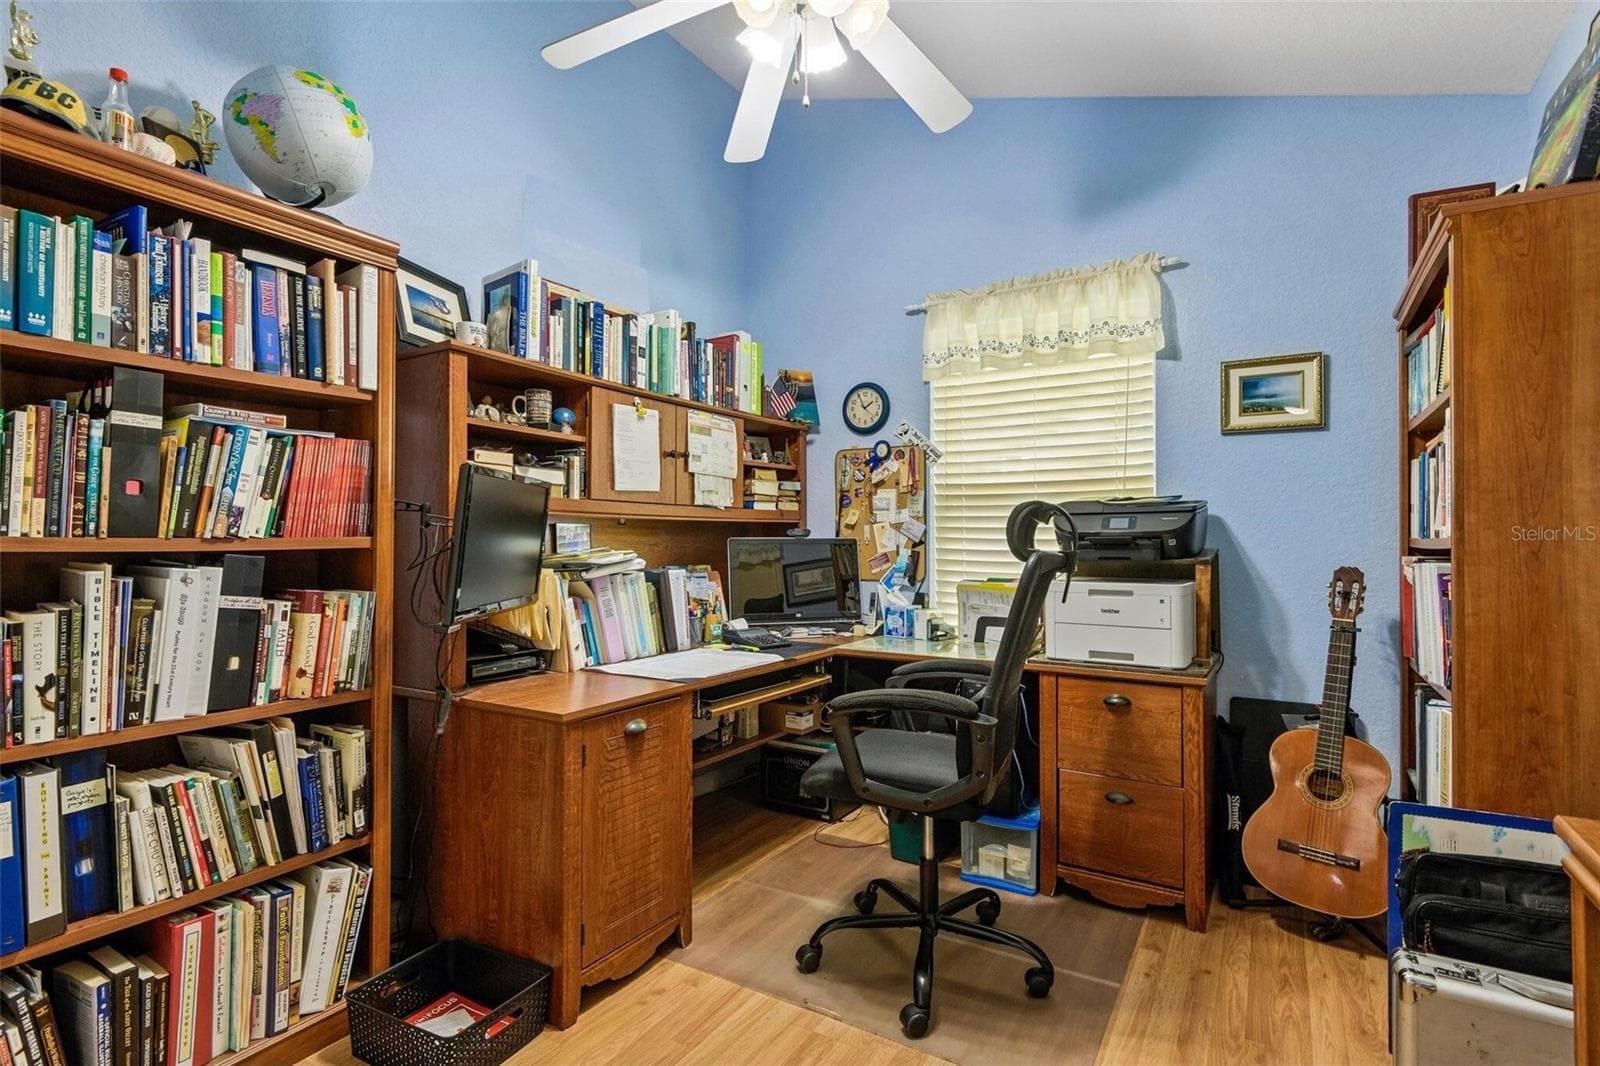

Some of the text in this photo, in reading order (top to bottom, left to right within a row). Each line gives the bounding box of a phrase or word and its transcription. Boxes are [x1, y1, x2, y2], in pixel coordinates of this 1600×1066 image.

[96, 255, 107, 309] christian history
[152, 237, 168, 285] Paul Johnson
[197, 259, 208, 294] HANDBOOK
[159, 302, 169, 323] History
[260, 280, 276, 318] HERESIES
[232, 429, 245, 456] CHOSEN
[90, 467, 100, 488] Grace
[33, 621, 43, 672] THE STORY
[89, 632, 100, 704] TIMELINE
[304, 621, 316, 668] God Good
[784, 756, 810, 768] UNION
[40, 782, 49, 845] EQUIPPING
[142, 806, 157, 839] SIMPE
[278, 906, 290, 934] Faith's
[338, 897, 364, 987] We Interrupt This Broadcast
[277, 935, 289, 987] Foundations
[15, 996, 41, 1061] DAYS THAT CHANGED
